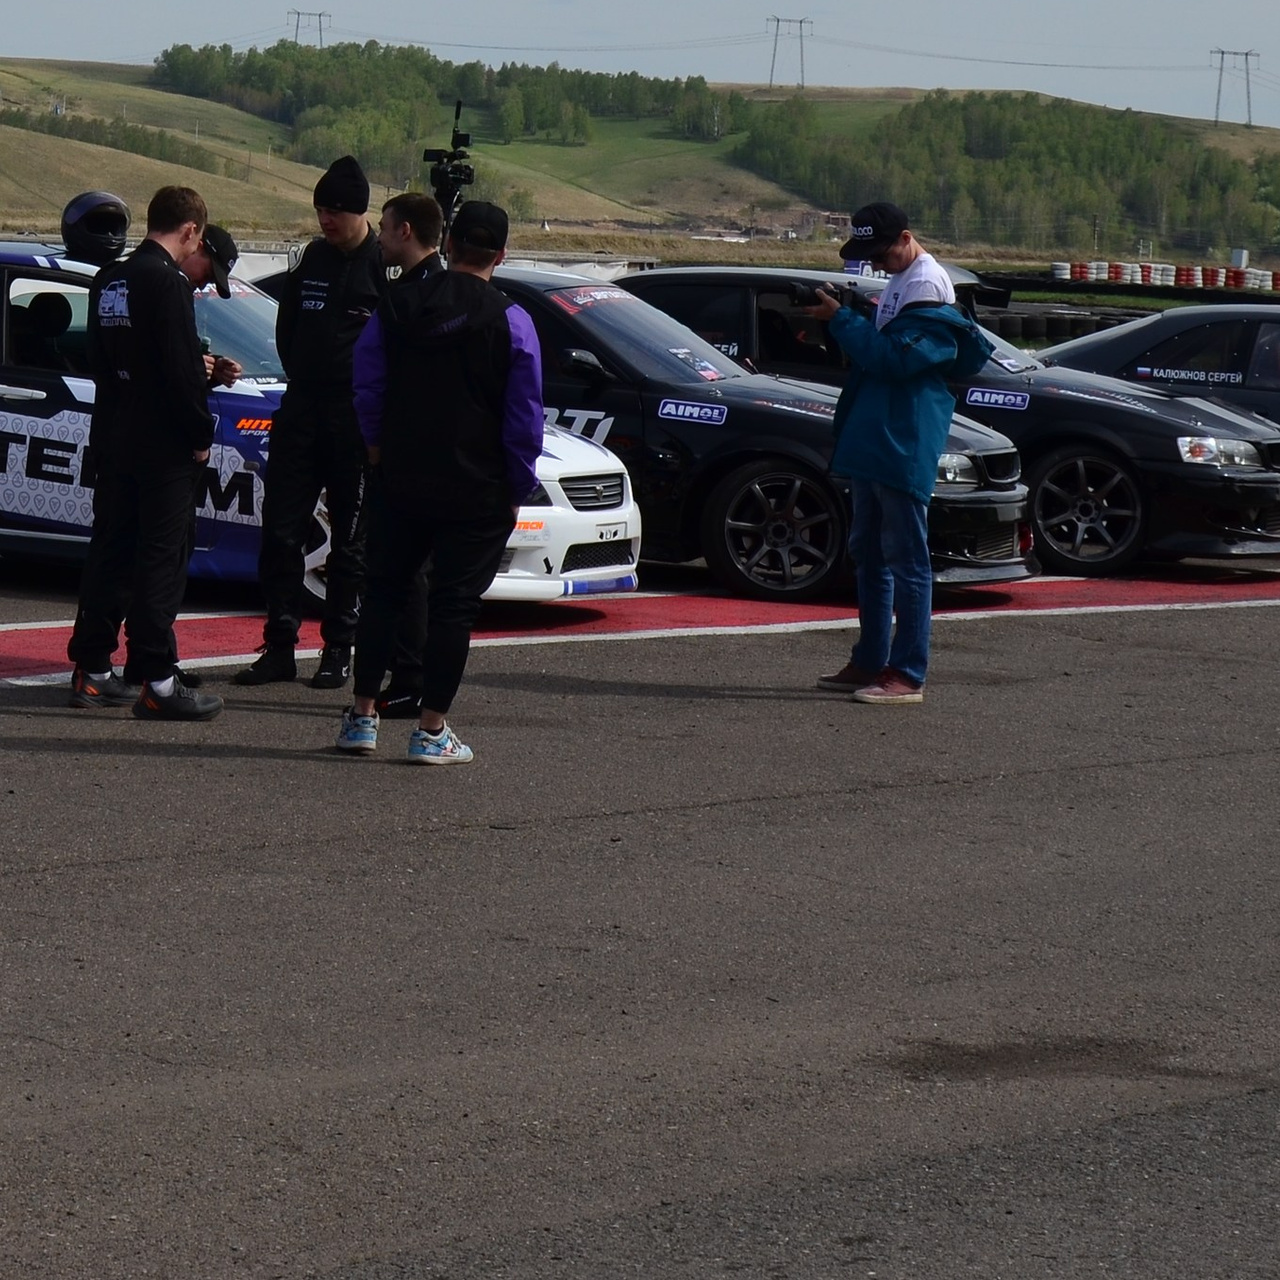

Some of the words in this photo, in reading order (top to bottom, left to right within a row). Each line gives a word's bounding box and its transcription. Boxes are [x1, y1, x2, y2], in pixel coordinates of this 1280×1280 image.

[1153, 368, 1206, 381] КАЛЮЖНОВ
[1207, 371, 1242, 383] СЕРГЕЙ
[969, 392, 1025, 407] AIMOL
[662, 404, 722, 420] AIMOL
